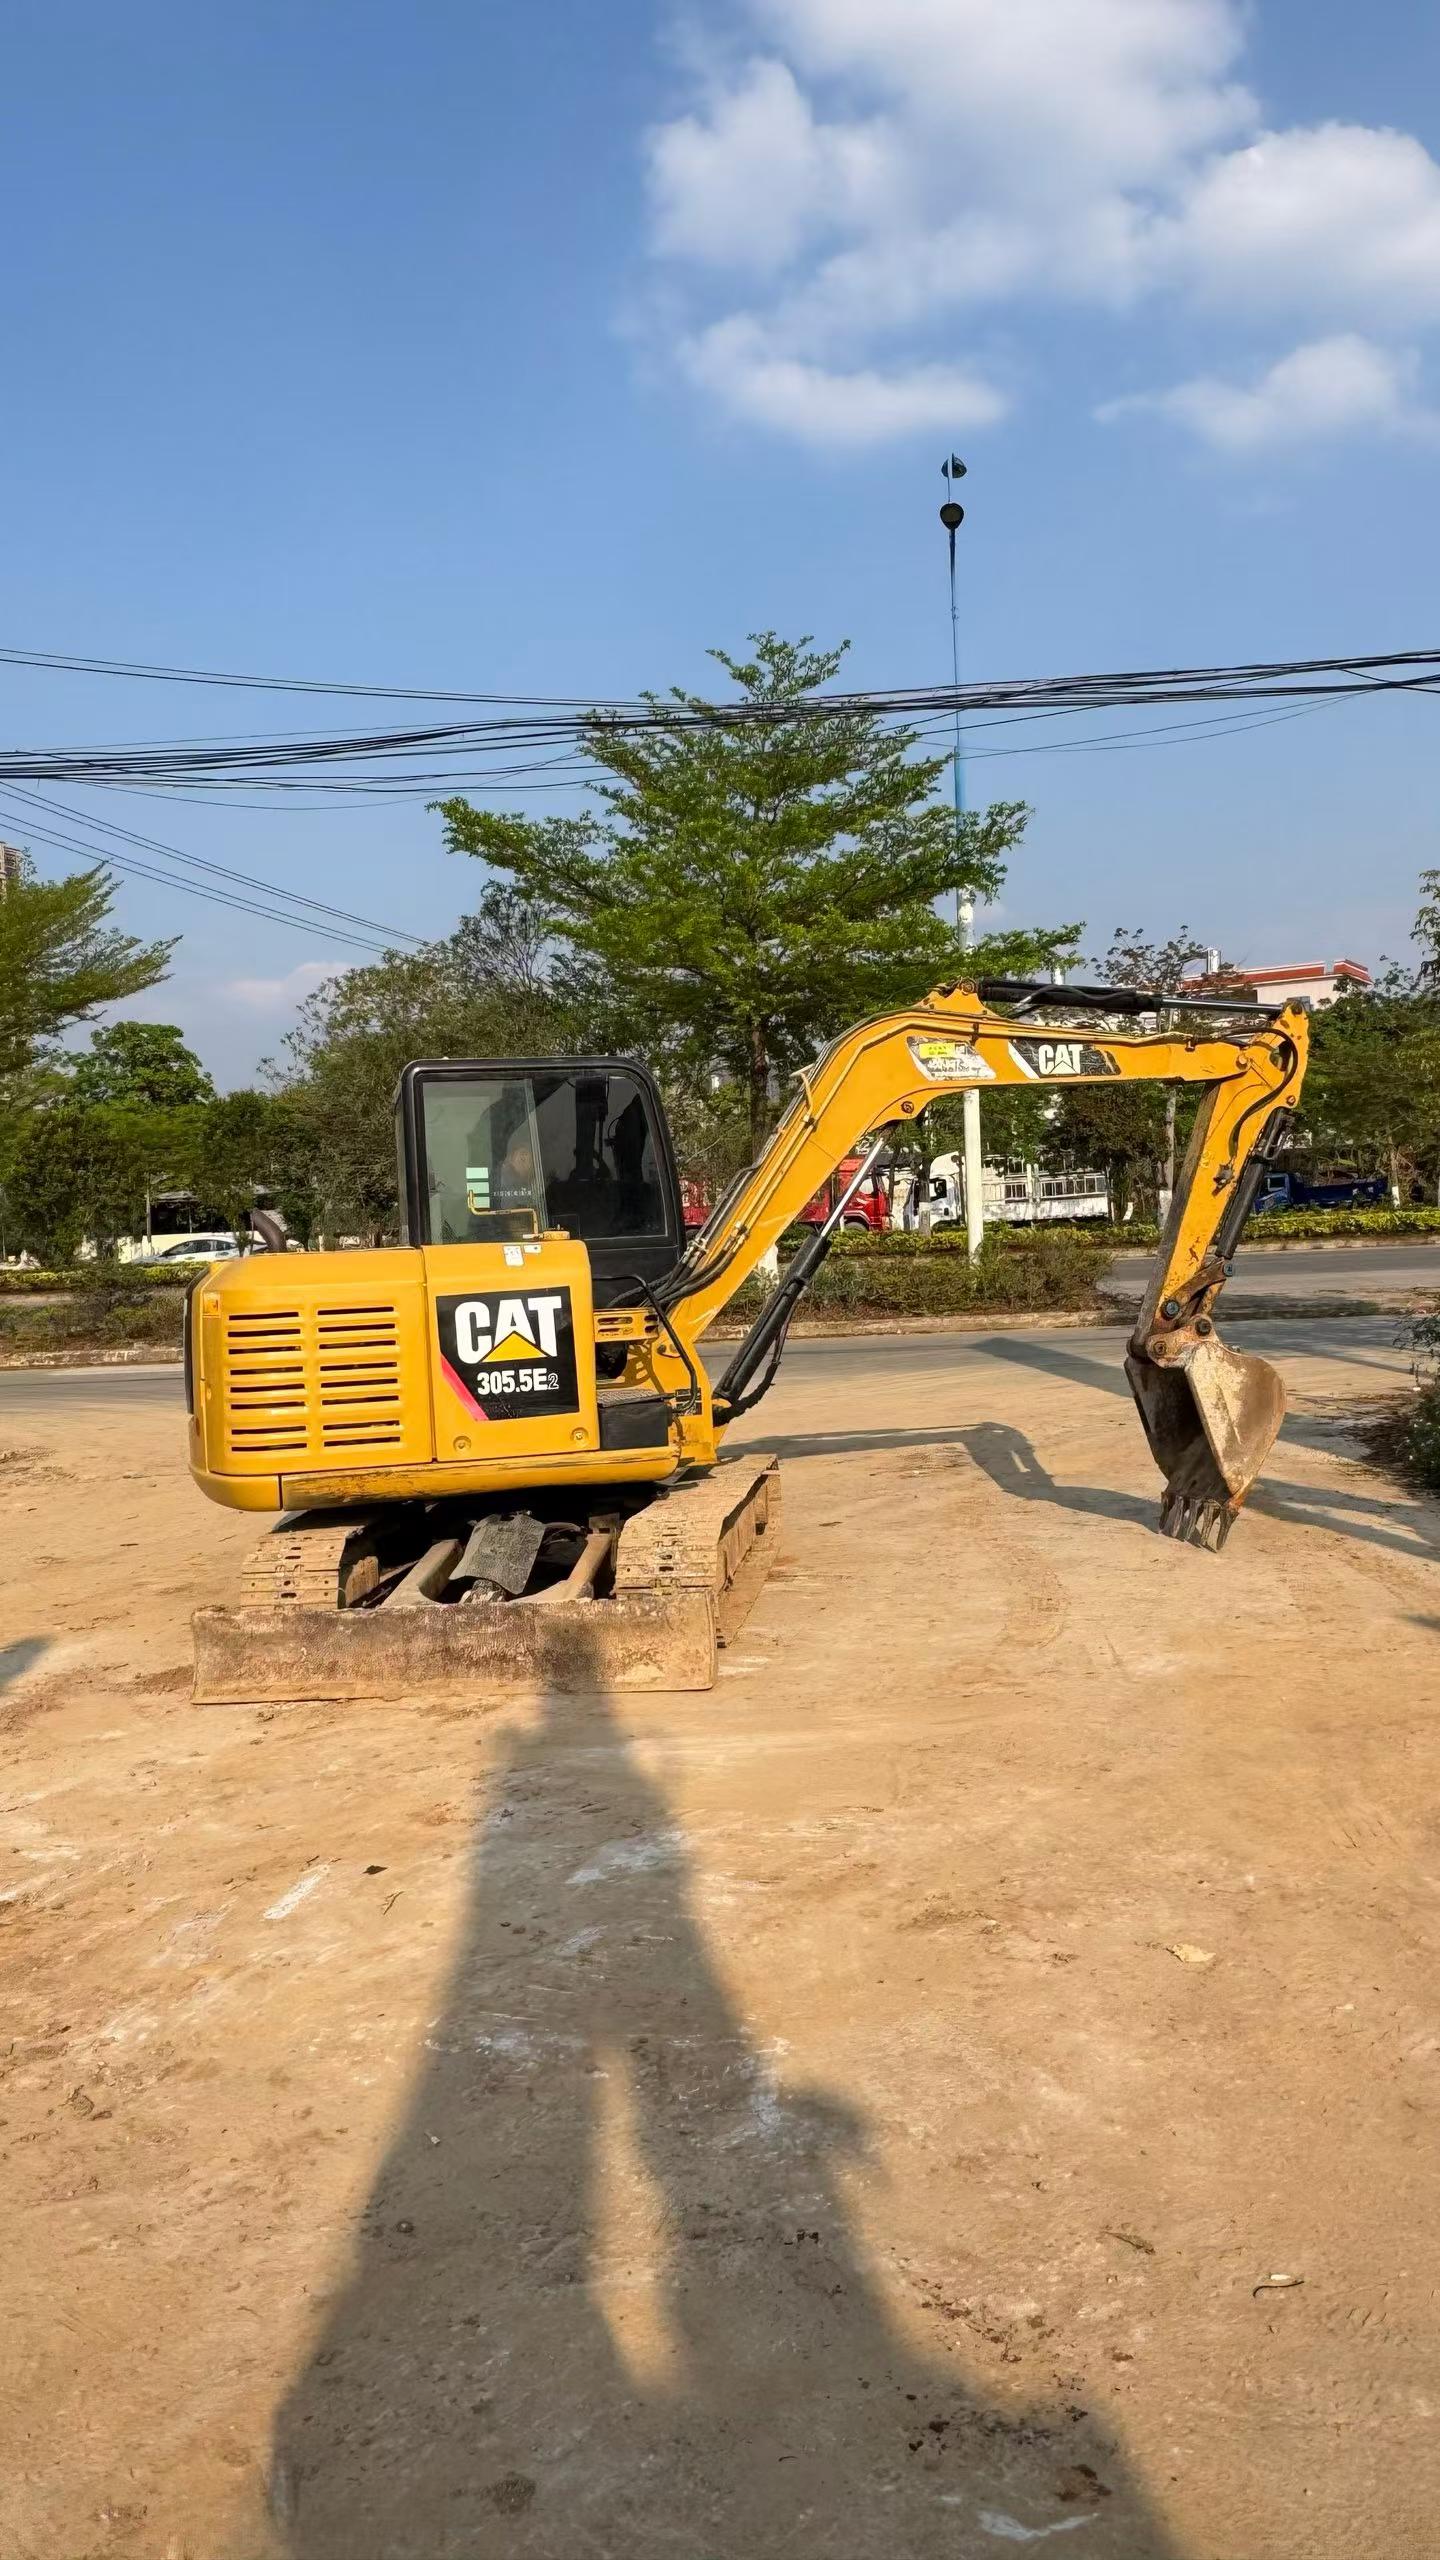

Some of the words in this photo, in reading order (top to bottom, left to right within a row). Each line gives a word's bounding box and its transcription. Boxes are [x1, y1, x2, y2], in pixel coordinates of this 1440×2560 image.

[1038, 1044, 1083, 1075] CAT
[455, 1295, 562, 1364] CAT
[477, 1367, 559, 1395] 305.5E2
